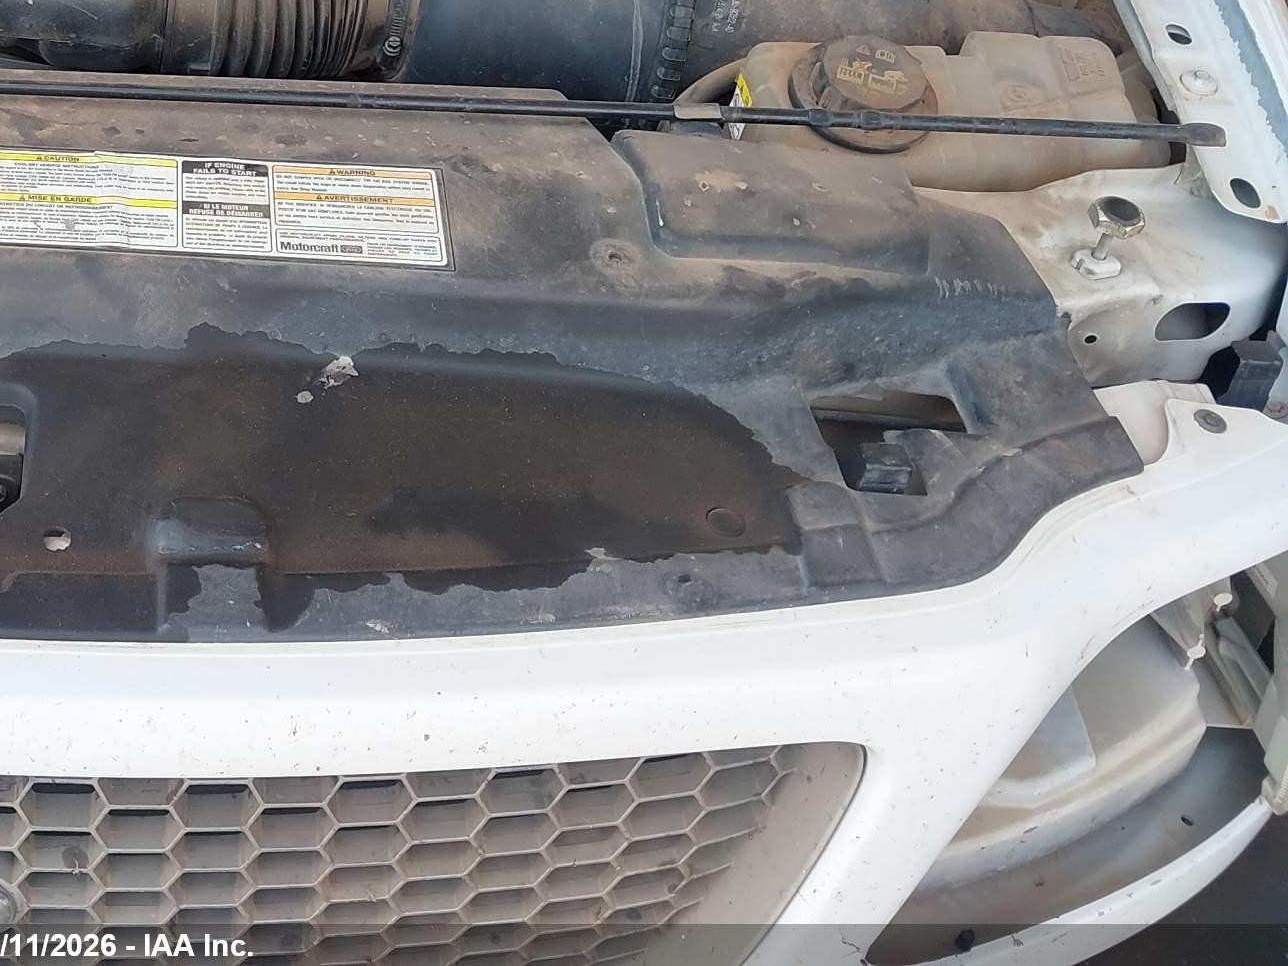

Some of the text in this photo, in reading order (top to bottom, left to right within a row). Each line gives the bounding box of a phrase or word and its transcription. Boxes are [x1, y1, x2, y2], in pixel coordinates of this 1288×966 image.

[43, 154, 80, 162] CAUTION
[214, 162, 245, 170] ENGINE
[324, 195, 392, 203] AVERTISSEMENT
[280, 241, 339, 253] Motorcraft
